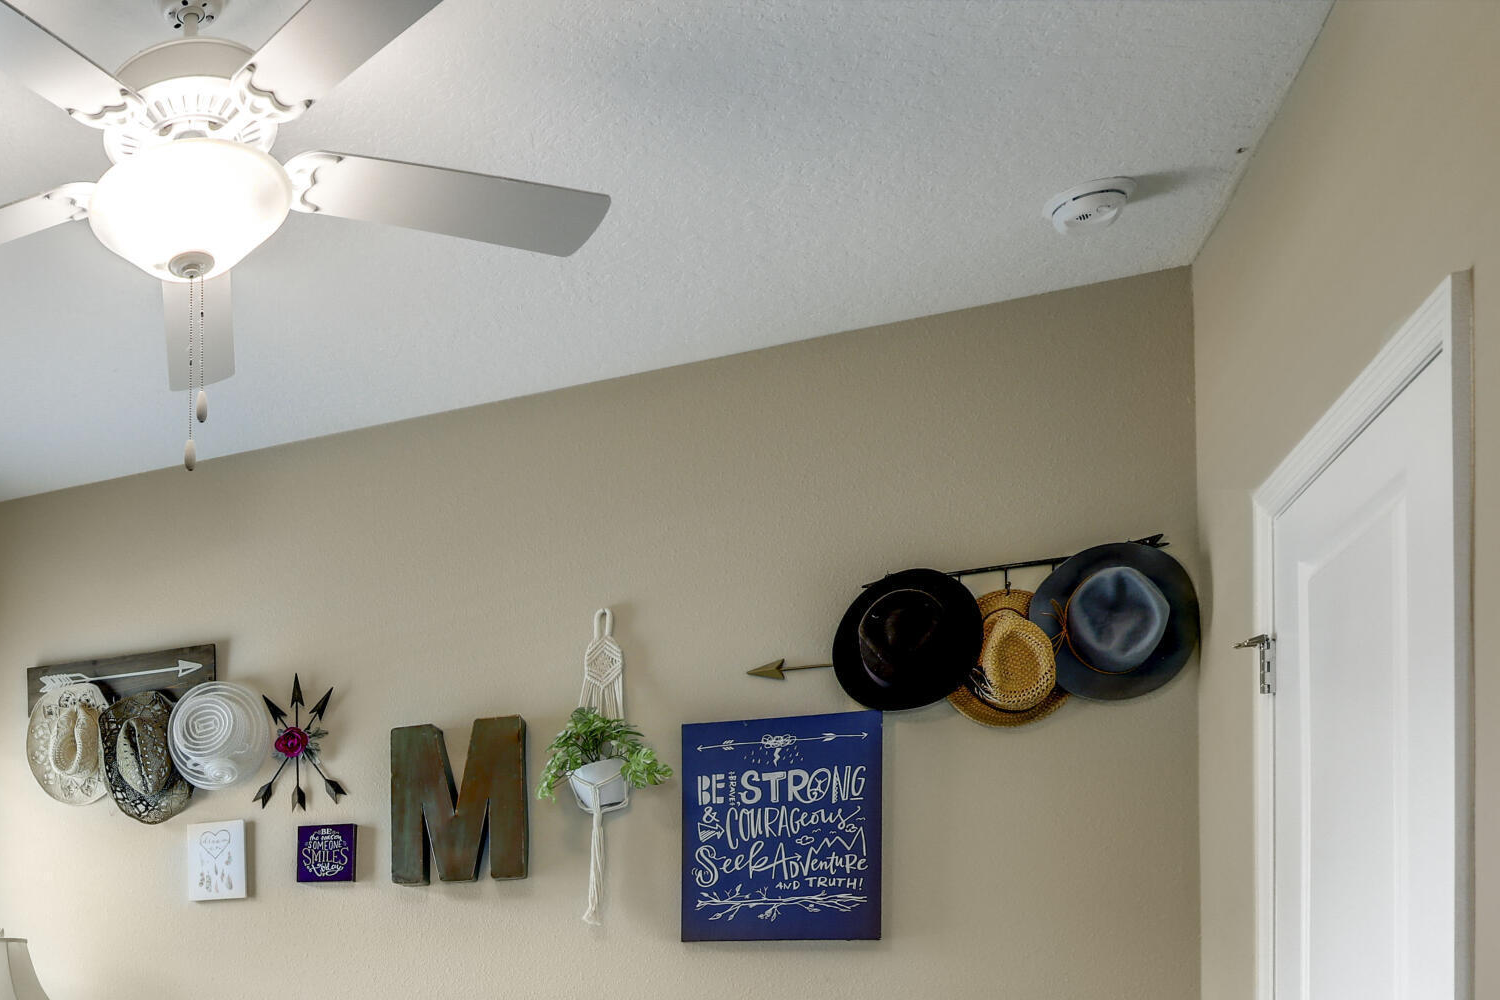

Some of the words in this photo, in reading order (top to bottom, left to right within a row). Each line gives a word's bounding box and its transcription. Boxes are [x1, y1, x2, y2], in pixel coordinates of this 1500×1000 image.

[697, 773, 726, 806] BE
[738, 766, 867, 805] STRONG
[308, 840, 343, 850] SOMEONE
[301, 847, 349, 866] SMILES
[775, 880, 801, 891] AND
[804, 876, 864, 891] TRUTH!
